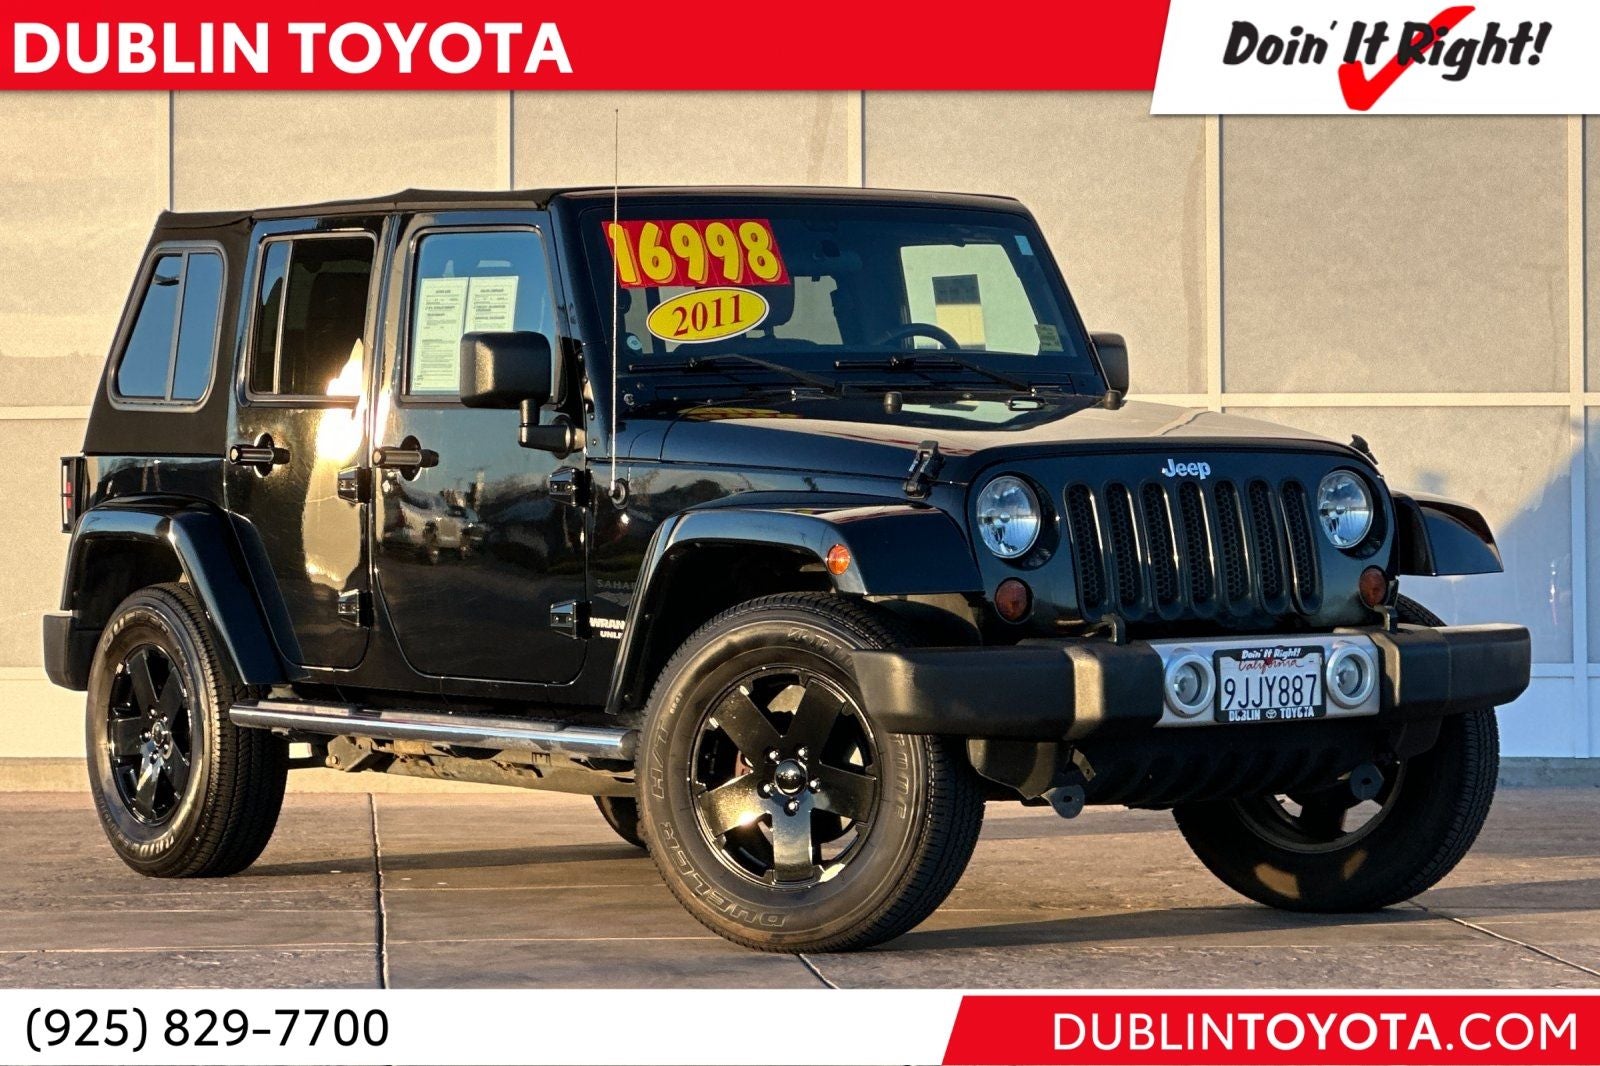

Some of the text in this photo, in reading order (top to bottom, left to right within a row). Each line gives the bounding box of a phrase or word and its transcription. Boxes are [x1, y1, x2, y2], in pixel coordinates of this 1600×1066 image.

[607, 221, 782, 285] 16998
[672, 293, 744, 337] 2011
[1161, 458, 1211, 480] Jeep
[1224, 674, 1317, 709] 9JJY887
